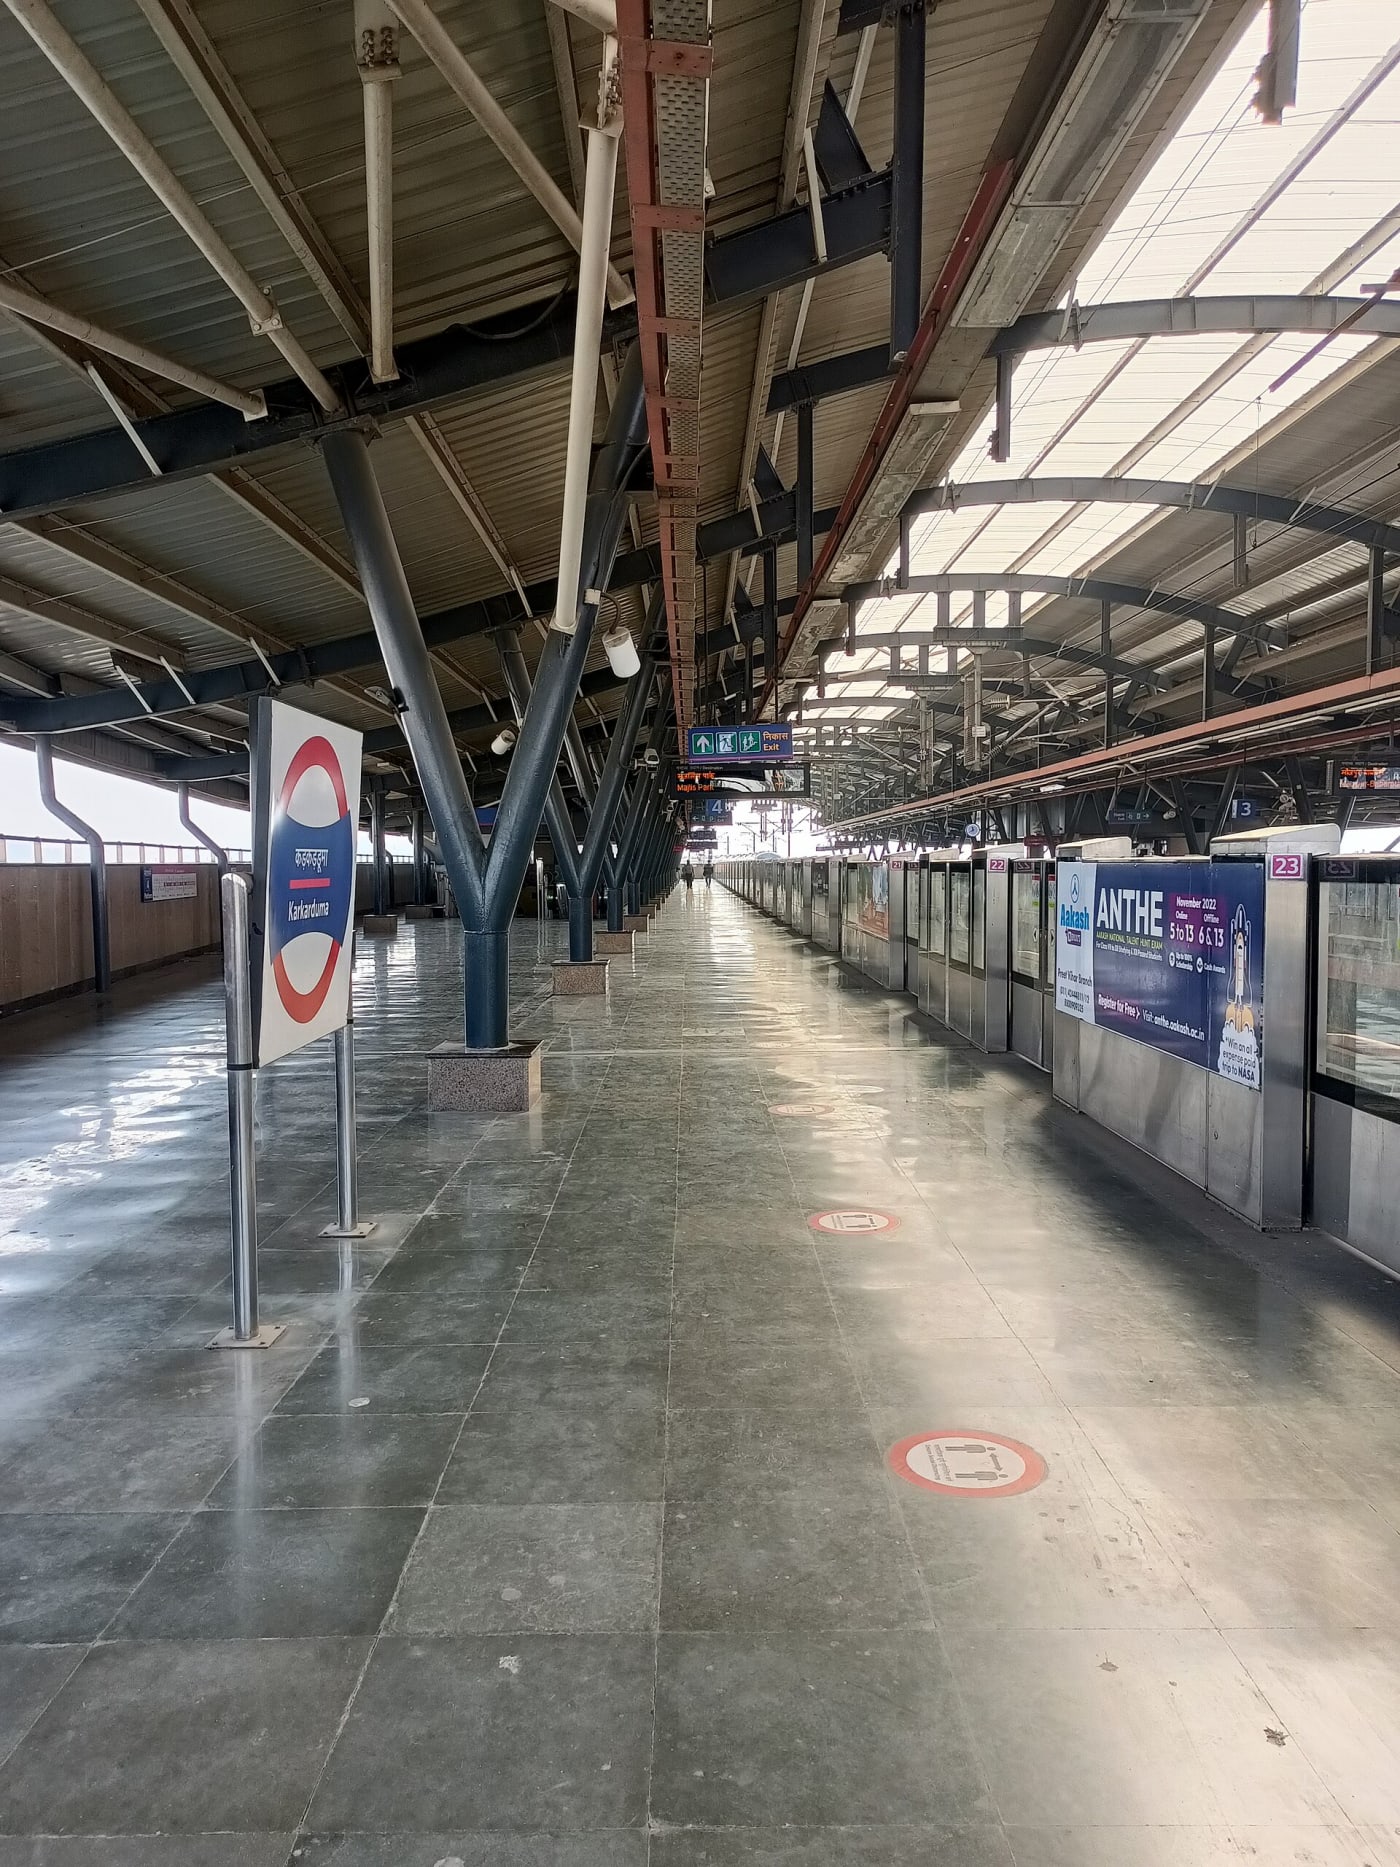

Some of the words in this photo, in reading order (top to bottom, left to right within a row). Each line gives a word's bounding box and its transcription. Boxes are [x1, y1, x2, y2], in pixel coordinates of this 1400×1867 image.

[763, 731, 789, 741] निकास
[677, 784, 696, 792] Majlis
[712, 800, 722, 814] 4
[1240, 802, 1252, 816] 3
[991, 860, 1004, 870] 22
[1275, 858, 1299, 874] 23
[288, 898, 329, 922] Karkarduma
[1176, 896, 1202, 908] November
[1202, 898, 1216, 910] 2022
[1060, 904, 1090, 930] Aakash
[1096, 888, 1164, 938] ANTHE
[1176, 910, 1188, 920] Online
[1170, 922, 1175, 940] 5
[1176, 924, 1184, 940] to
[1185, 924, 1194, 942] 13
[1199, 926, 1204, 944] 6
[1206, 927, 1212, 946] &
[1214, 928, 1224, 948] 13
[1109, 933, 1126, 944] NATIONAL
[1126, 936, 1139, 946] TALENT
[1140, 938, 1151, 948] HUNT
[1152, 940, 1163, 950] EXAM
[1204, 962, 1212, 970] Cash
[1213, 964, 1226, 974] Awards
[1078, 974, 1092, 987] Branch
[1098, 994, 1116, 1009] Register
[1125, 1002, 1136, 1017] Free
[1142, 1009, 1154, 1023] Visit:
[1154, 1015, 1204, 1040] anthe.aakash.ac.in
[1223, 1050, 1243, 1064] expense
[1244, 1057, 1256, 1068] paid
[1232, 1064, 1237, 1075] to
[1238, 1066, 1255, 1082] NASA
